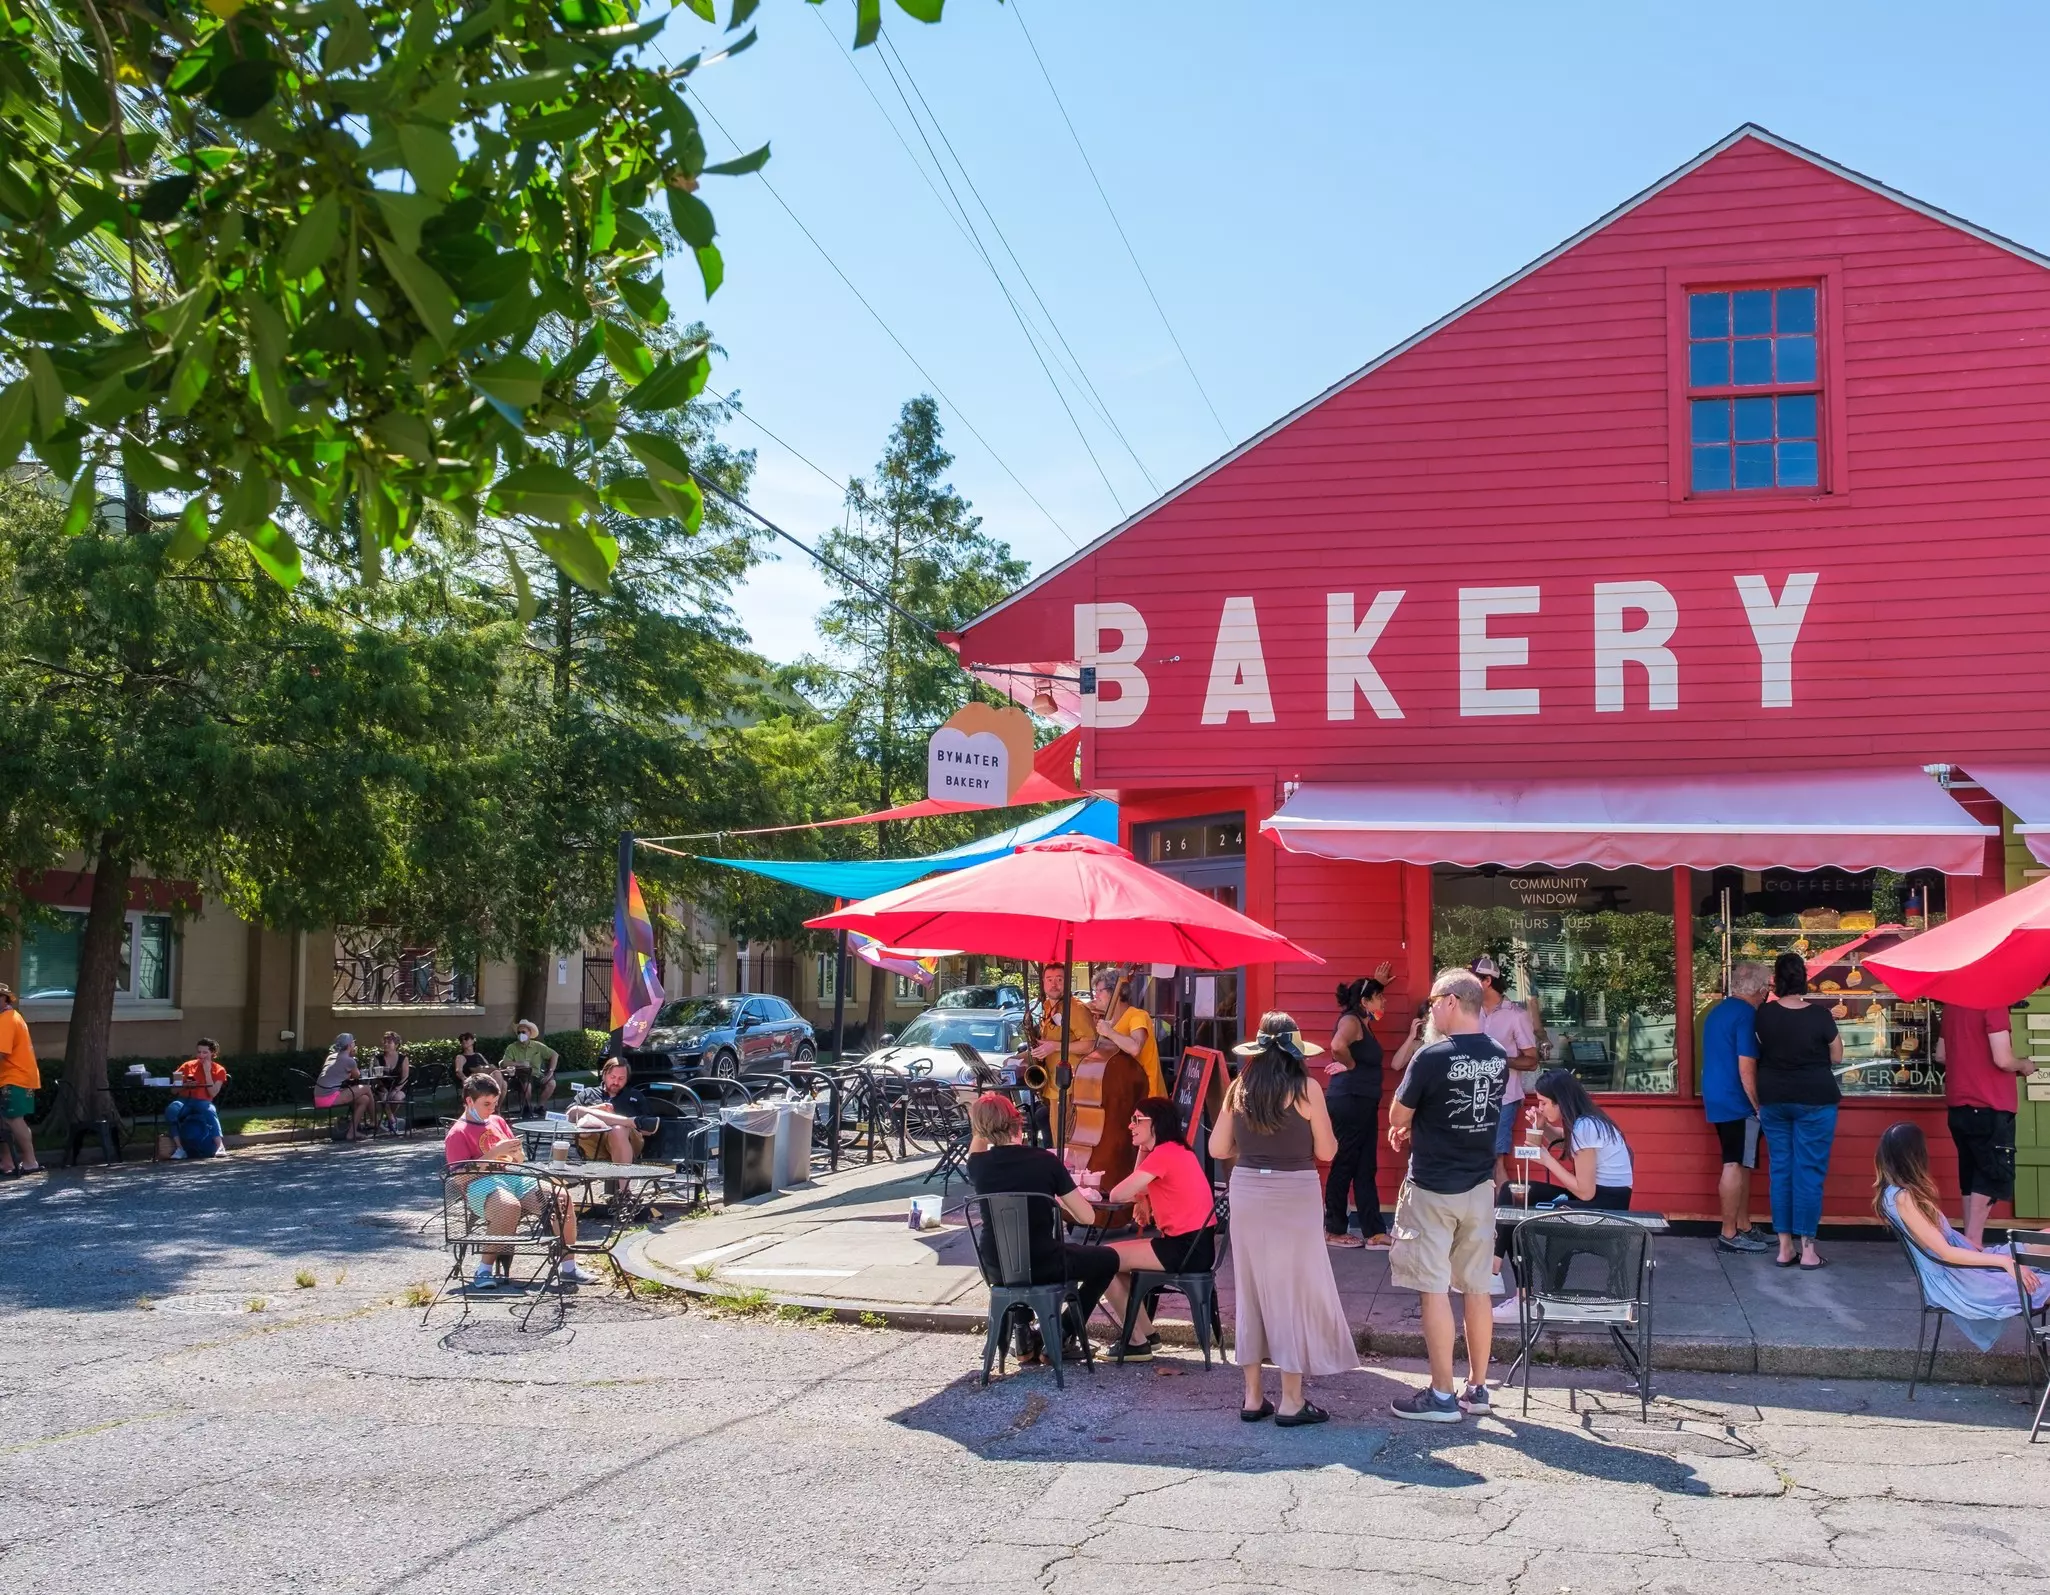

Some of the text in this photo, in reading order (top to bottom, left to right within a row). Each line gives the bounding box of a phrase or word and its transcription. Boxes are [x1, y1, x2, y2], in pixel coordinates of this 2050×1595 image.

[1073, 572, 1820, 728] BAKERY
[936, 749, 1000, 768] BYWATER
[945, 774, 991, 790] BAKERY
[1509, 877, 1589, 890] COMMUNITY
[1520, 893, 1578, 904] WINDOW
[1508, 918, 1549, 929] THURS
[1560, 917, 1592, 929] TUES
[1909, 1069, 1946, 1086] DAY
